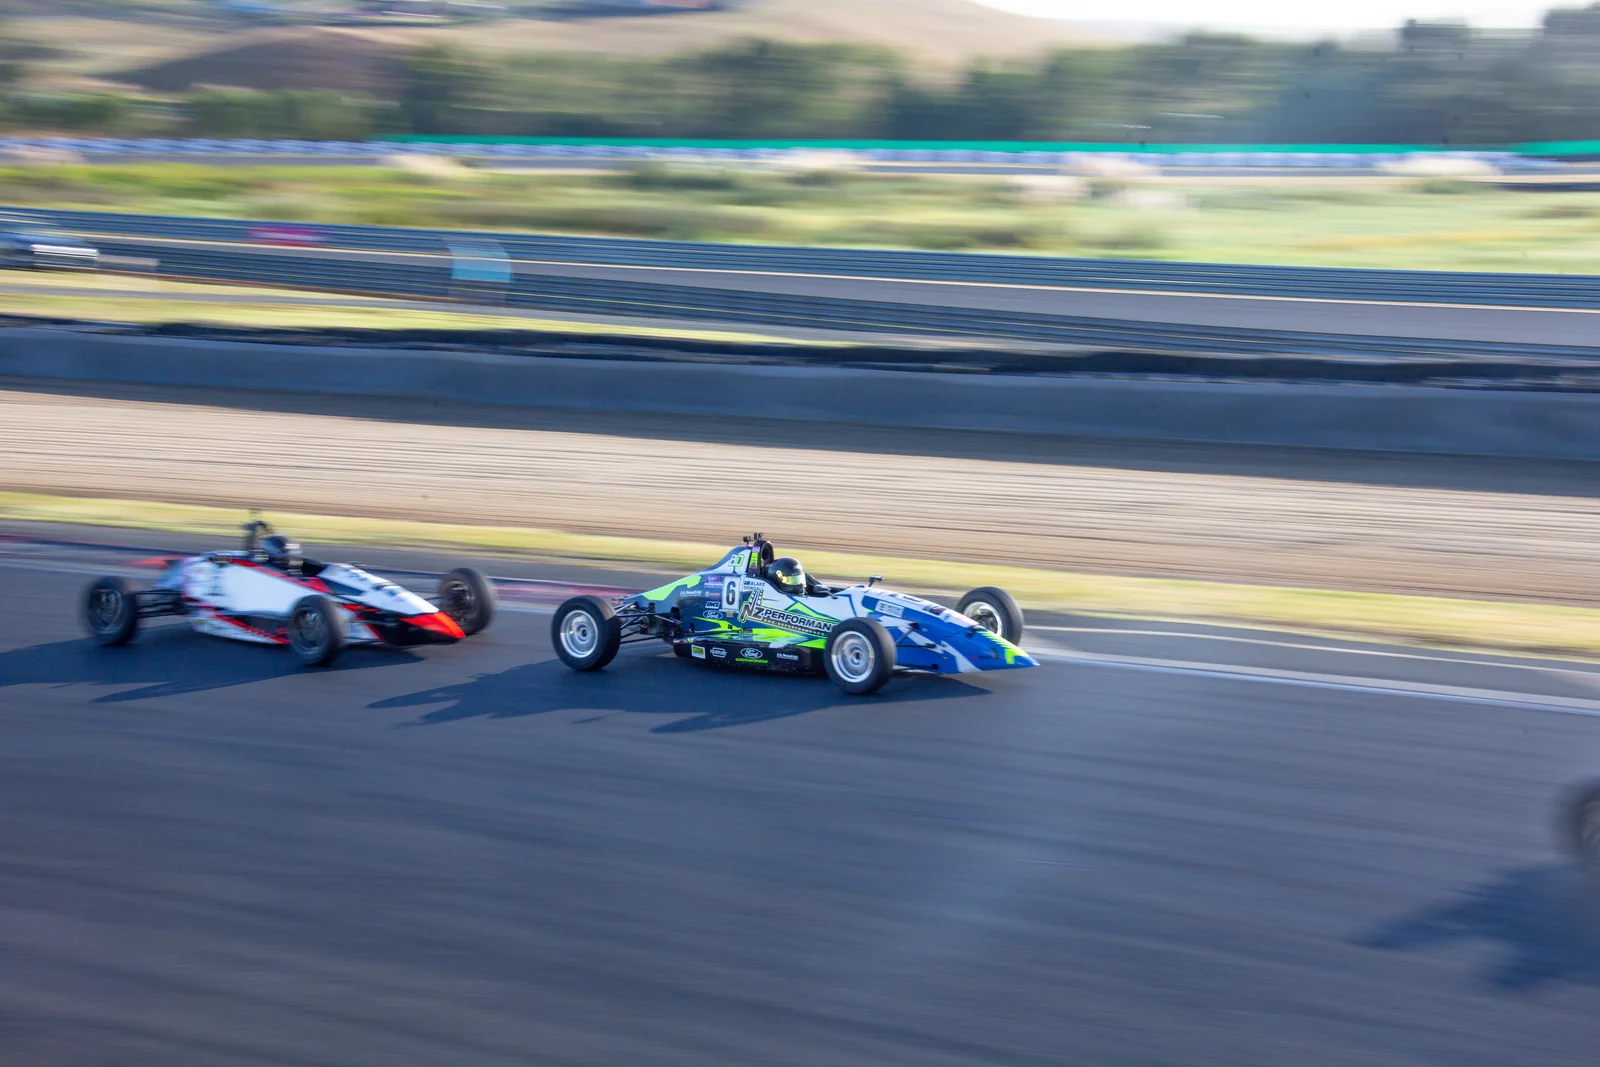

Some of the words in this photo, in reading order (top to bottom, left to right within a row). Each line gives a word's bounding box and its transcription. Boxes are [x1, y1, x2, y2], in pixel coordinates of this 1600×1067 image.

[725, 581, 736, 606] 6
[705, 611, 720, 619] Ford
[743, 648, 760, 658] Ford
